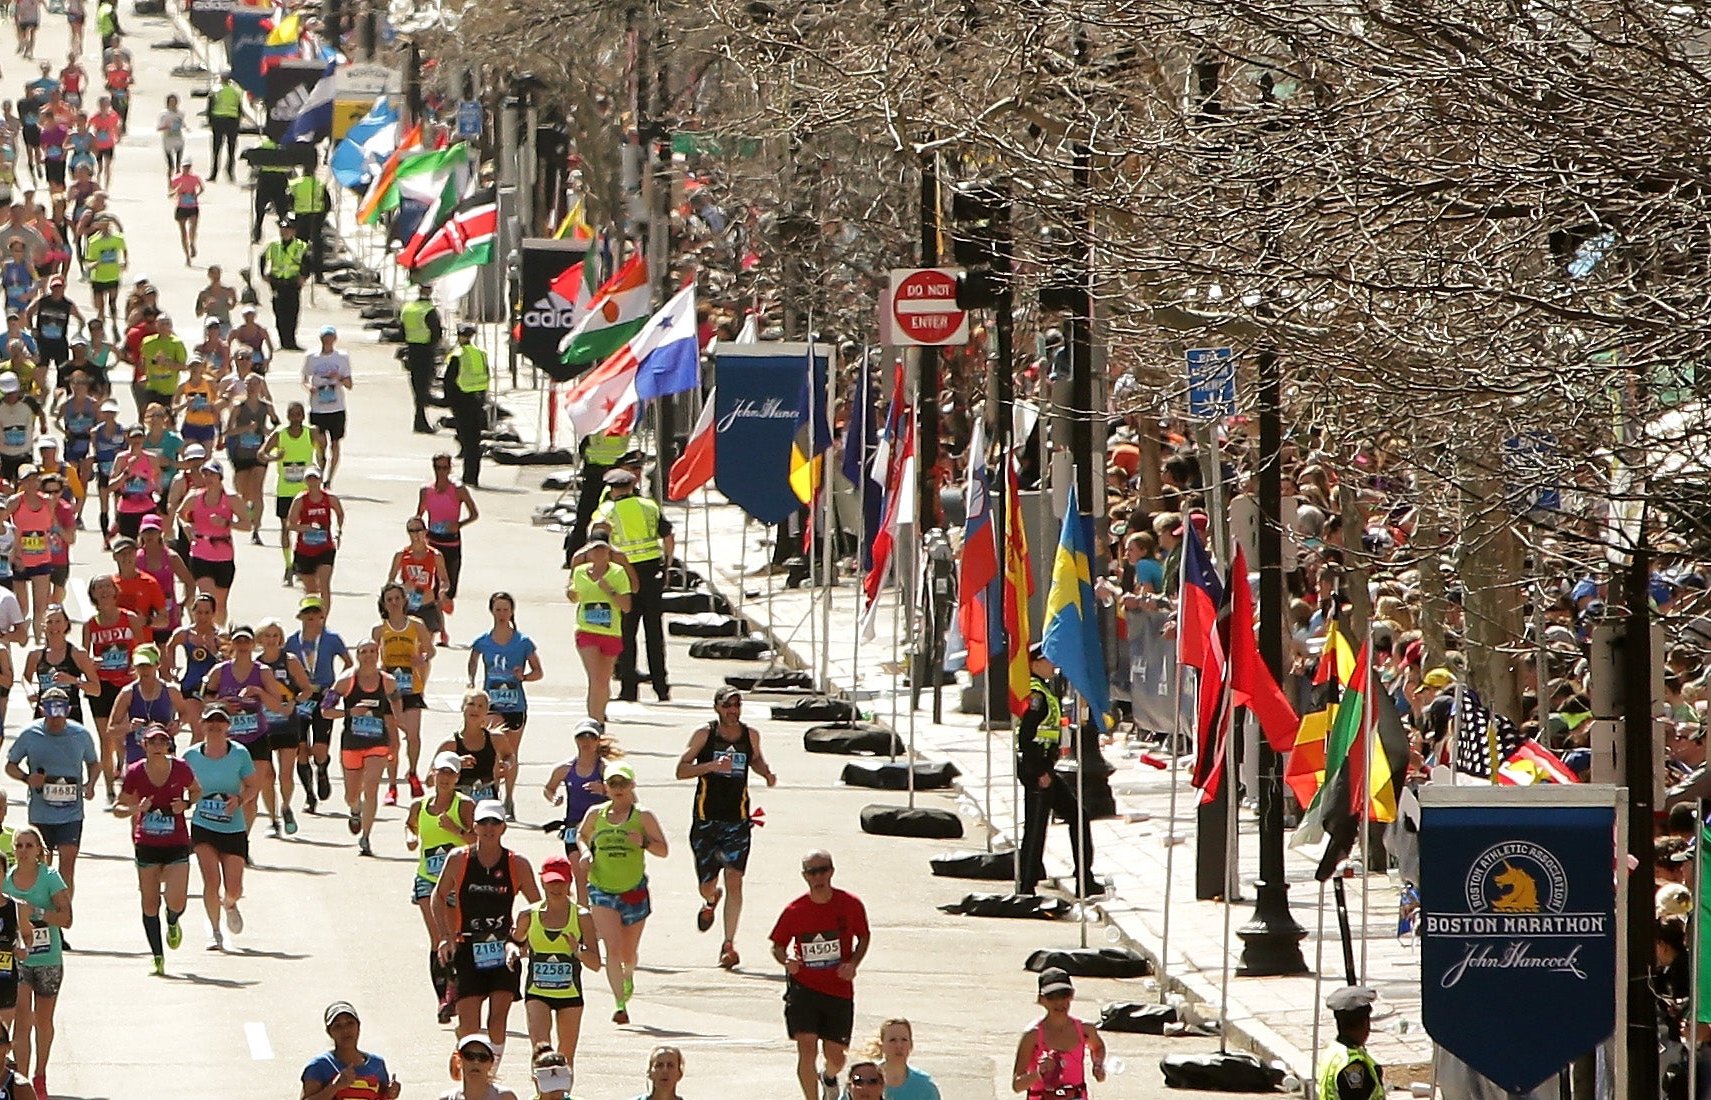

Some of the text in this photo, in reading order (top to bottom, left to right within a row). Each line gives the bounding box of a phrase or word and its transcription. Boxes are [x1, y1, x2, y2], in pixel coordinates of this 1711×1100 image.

[906, 284, 950, 297] DO NOT
[523, 310, 575, 329] adid
[911, 314, 949, 330] ENTER
[716, 397, 761, 433] John
[1468, 844, 1566, 909] BOSTON ATHLETIC ASSOCIATION
[1426, 916, 1604, 933] BOSTON MARATHON
[475, 943, 505, 956] 2185
[803, 940, 841, 955] 14505
[534, 963, 572, 975] 22582
[1440, 940, 1588, 989] John Hancock
